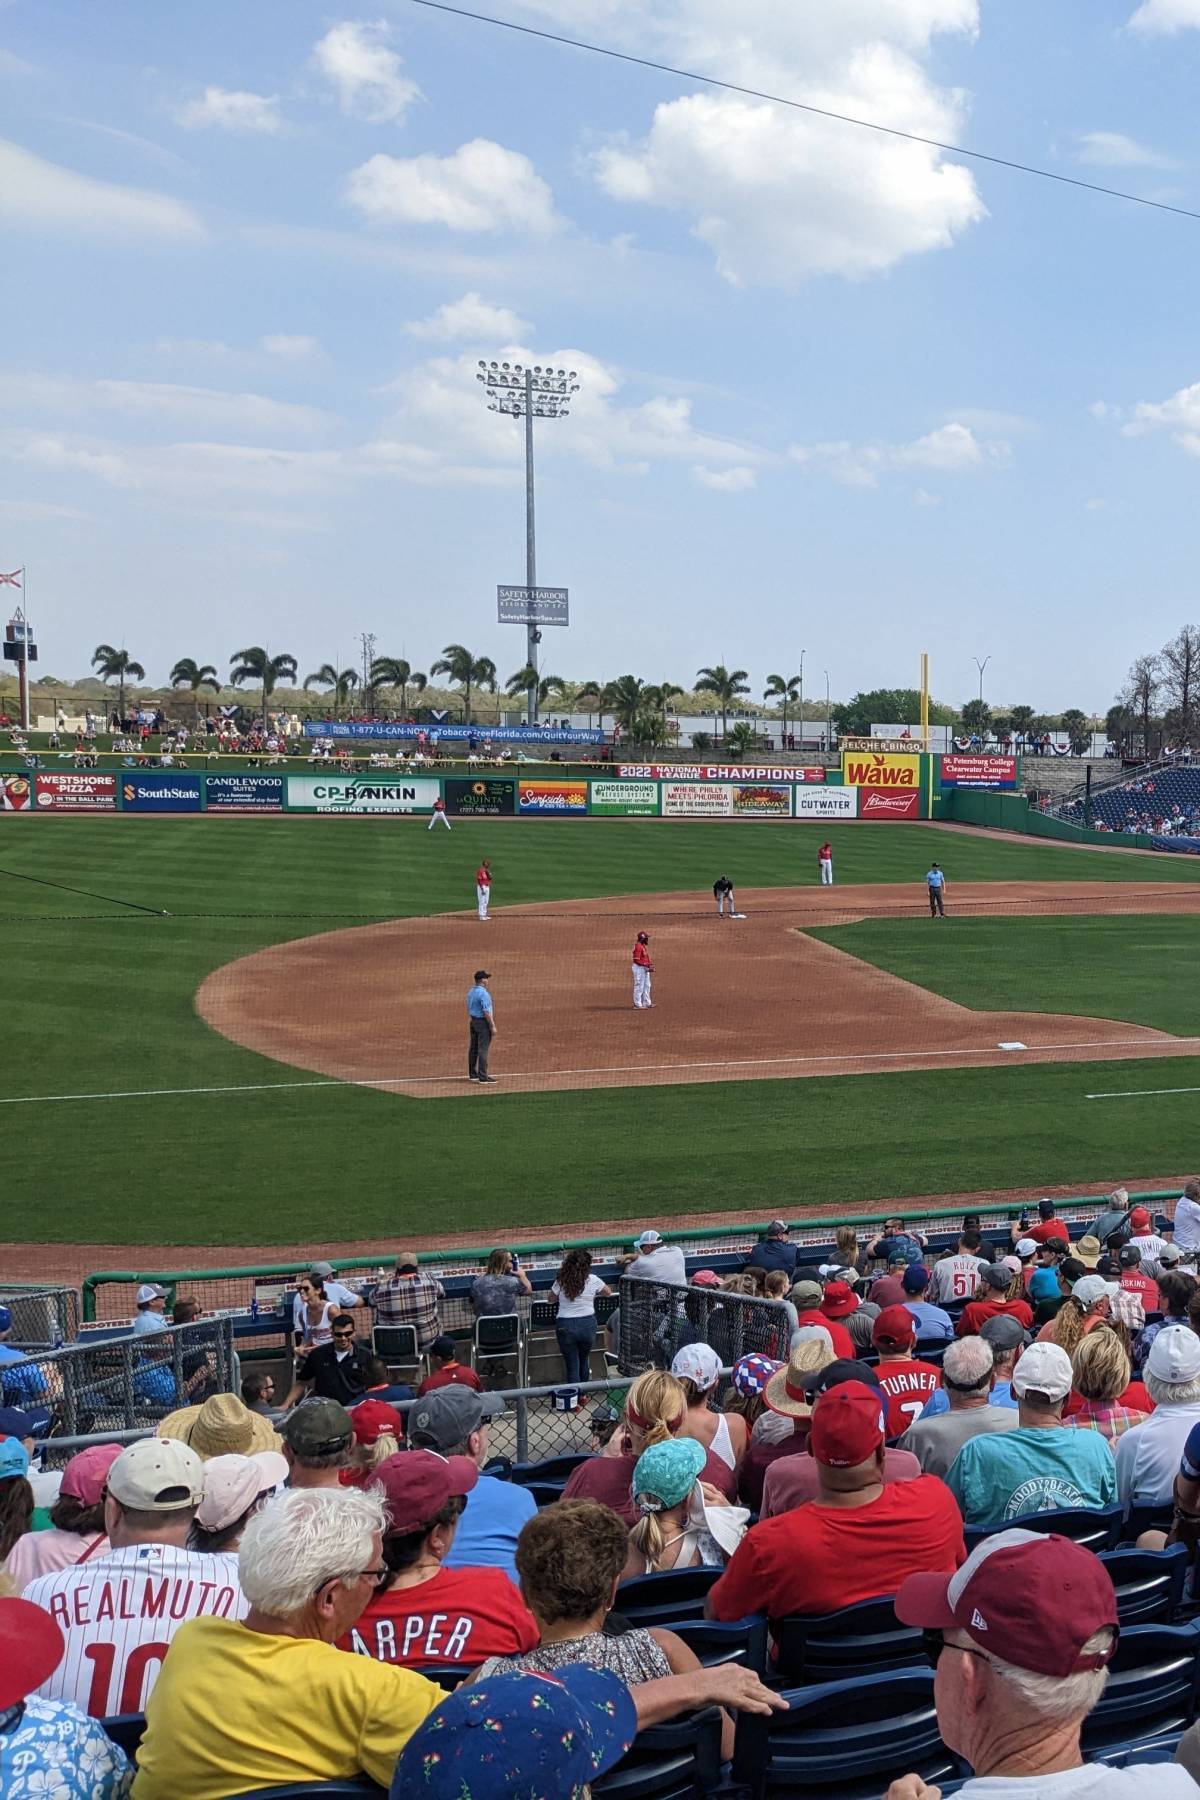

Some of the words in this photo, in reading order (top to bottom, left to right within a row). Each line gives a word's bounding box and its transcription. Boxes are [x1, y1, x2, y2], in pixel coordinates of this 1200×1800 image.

[500, 590, 529, 598] SAFETY
[531, 591, 567, 600] HARBOR
[842, 741, 886, 750] BELCHER
[889, 742, 920, 751] BINGO
[953, 757, 988, 766] Petersburg
[989, 758, 1015, 767] College
[619, 766, 651, 777] 2022
[706, 767, 805, 780] CHAMPIONS
[848, 763, 914, 785] Wawa
[946, 765, 982, 773] Clearwater
[983, 766, 1011, 774] Campus
[40, 775, 113, 785] WESTSHORE
[206, 777, 282, 786] CANDLEWOOD
[59, 784, 93, 793] PIZZA
[138, 787, 199, 799] SouthState
[313, 786, 416, 800] CP-RANKIN
[519, 789, 565, 808] Surfside
[869, 797, 910, 807] Budweiser
[801, 800, 850, 809] CUTWATER
[924, 1226, 961, 1234] HOOTERS
[696, 1247, 738, 1256] HOOTERS
[953, 1261, 976, 1271] RUIZ
[953, 1273, 976, 1297] 51
[79, 1319, 132, 1330] HOOTERS
[880, 1372, 937, 1397] TURNER
[900, 1401, 924, 1425] 7
[1008, 1480, 1043, 1511] MOODY
[50, 1577, 235, 1629] REALMUTO
[351, 1614, 473, 1661] ARPER
